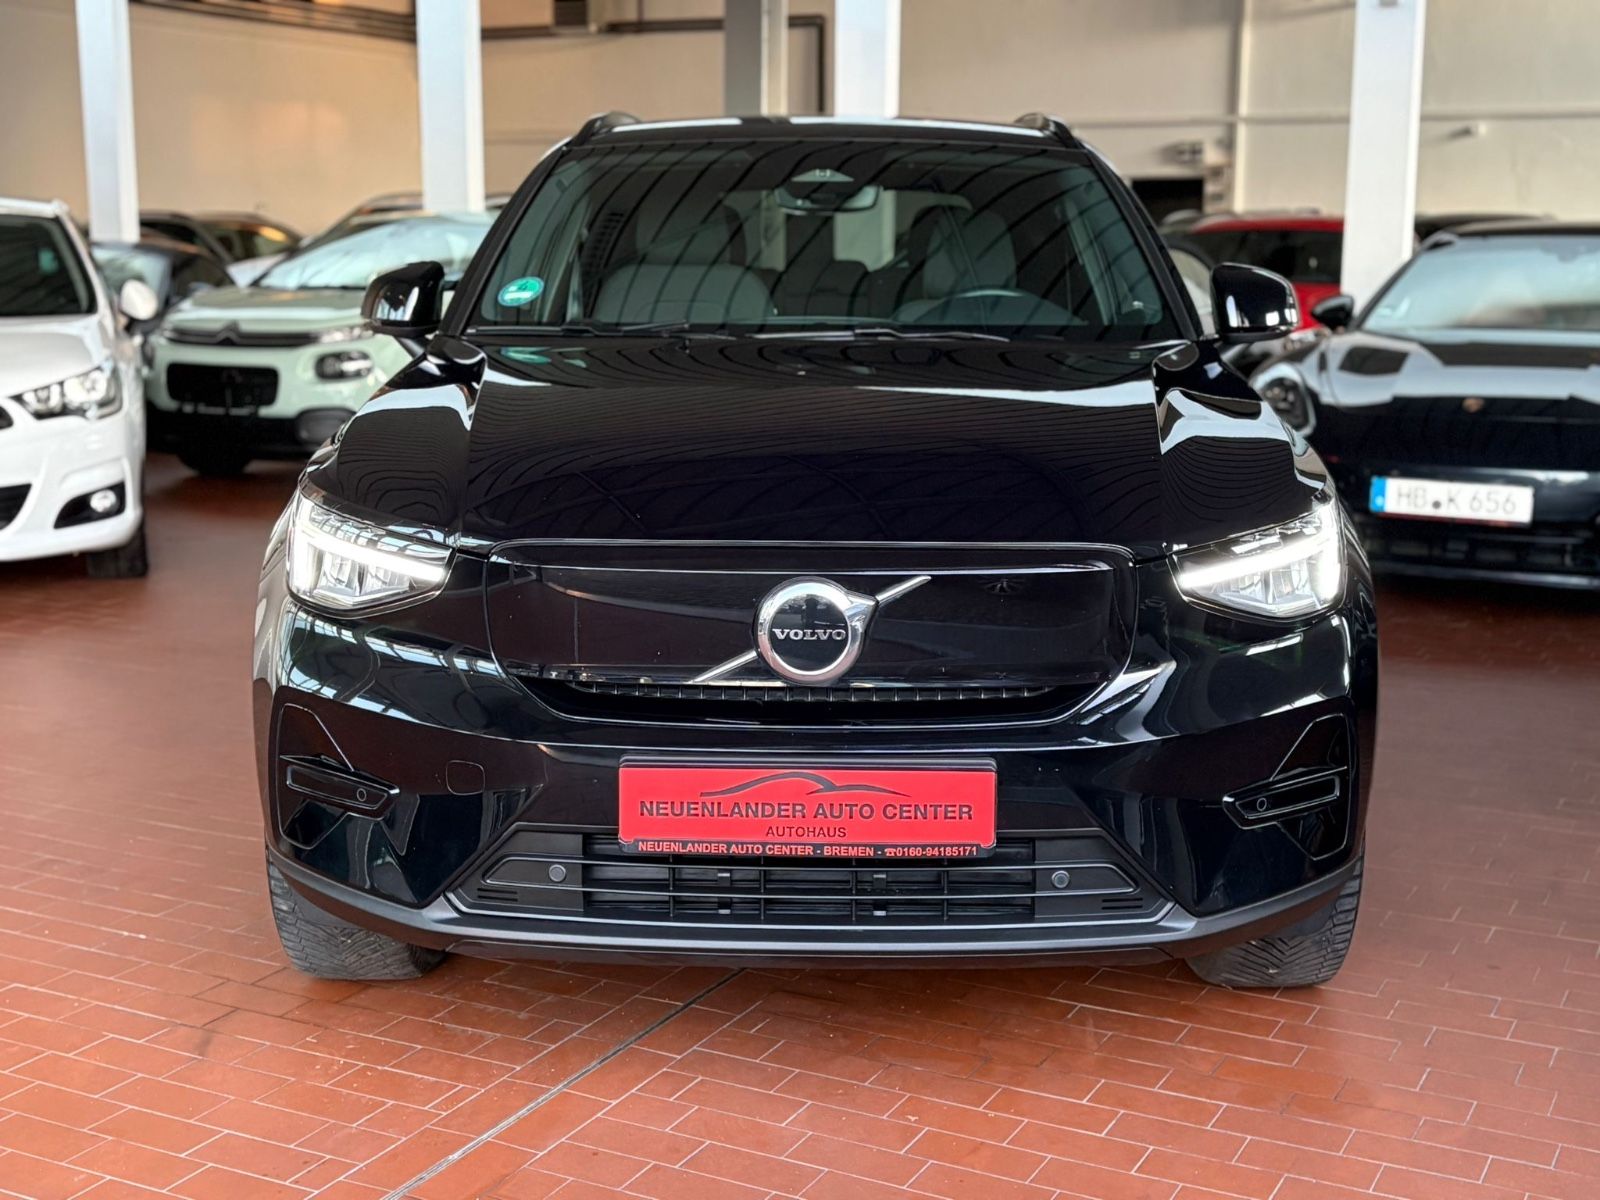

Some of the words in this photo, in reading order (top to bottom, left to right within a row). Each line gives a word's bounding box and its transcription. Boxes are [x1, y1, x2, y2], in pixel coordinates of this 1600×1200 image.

[1396, 484, 1427, 509] HB
[1446, 487, 1461, 512] K
[1469, 490, 1517, 515] 656
[772, 628, 846, 640] VOLVO
[639, 800, 806, 819] NEUENLANDER
[813, 803, 875, 820] AUTO
[882, 804, 973, 821] CENTER
[765, 826, 847, 838] AUTOHAUS
[638, 841, 727, 854] NEUENLANDER
[730, 844, 762, 855] AUTO
[765, 845, 813, 856] CENTER
[824, 846, 874, 857] BREMEN
[896, 847, 977, 857] 0160-94185171
